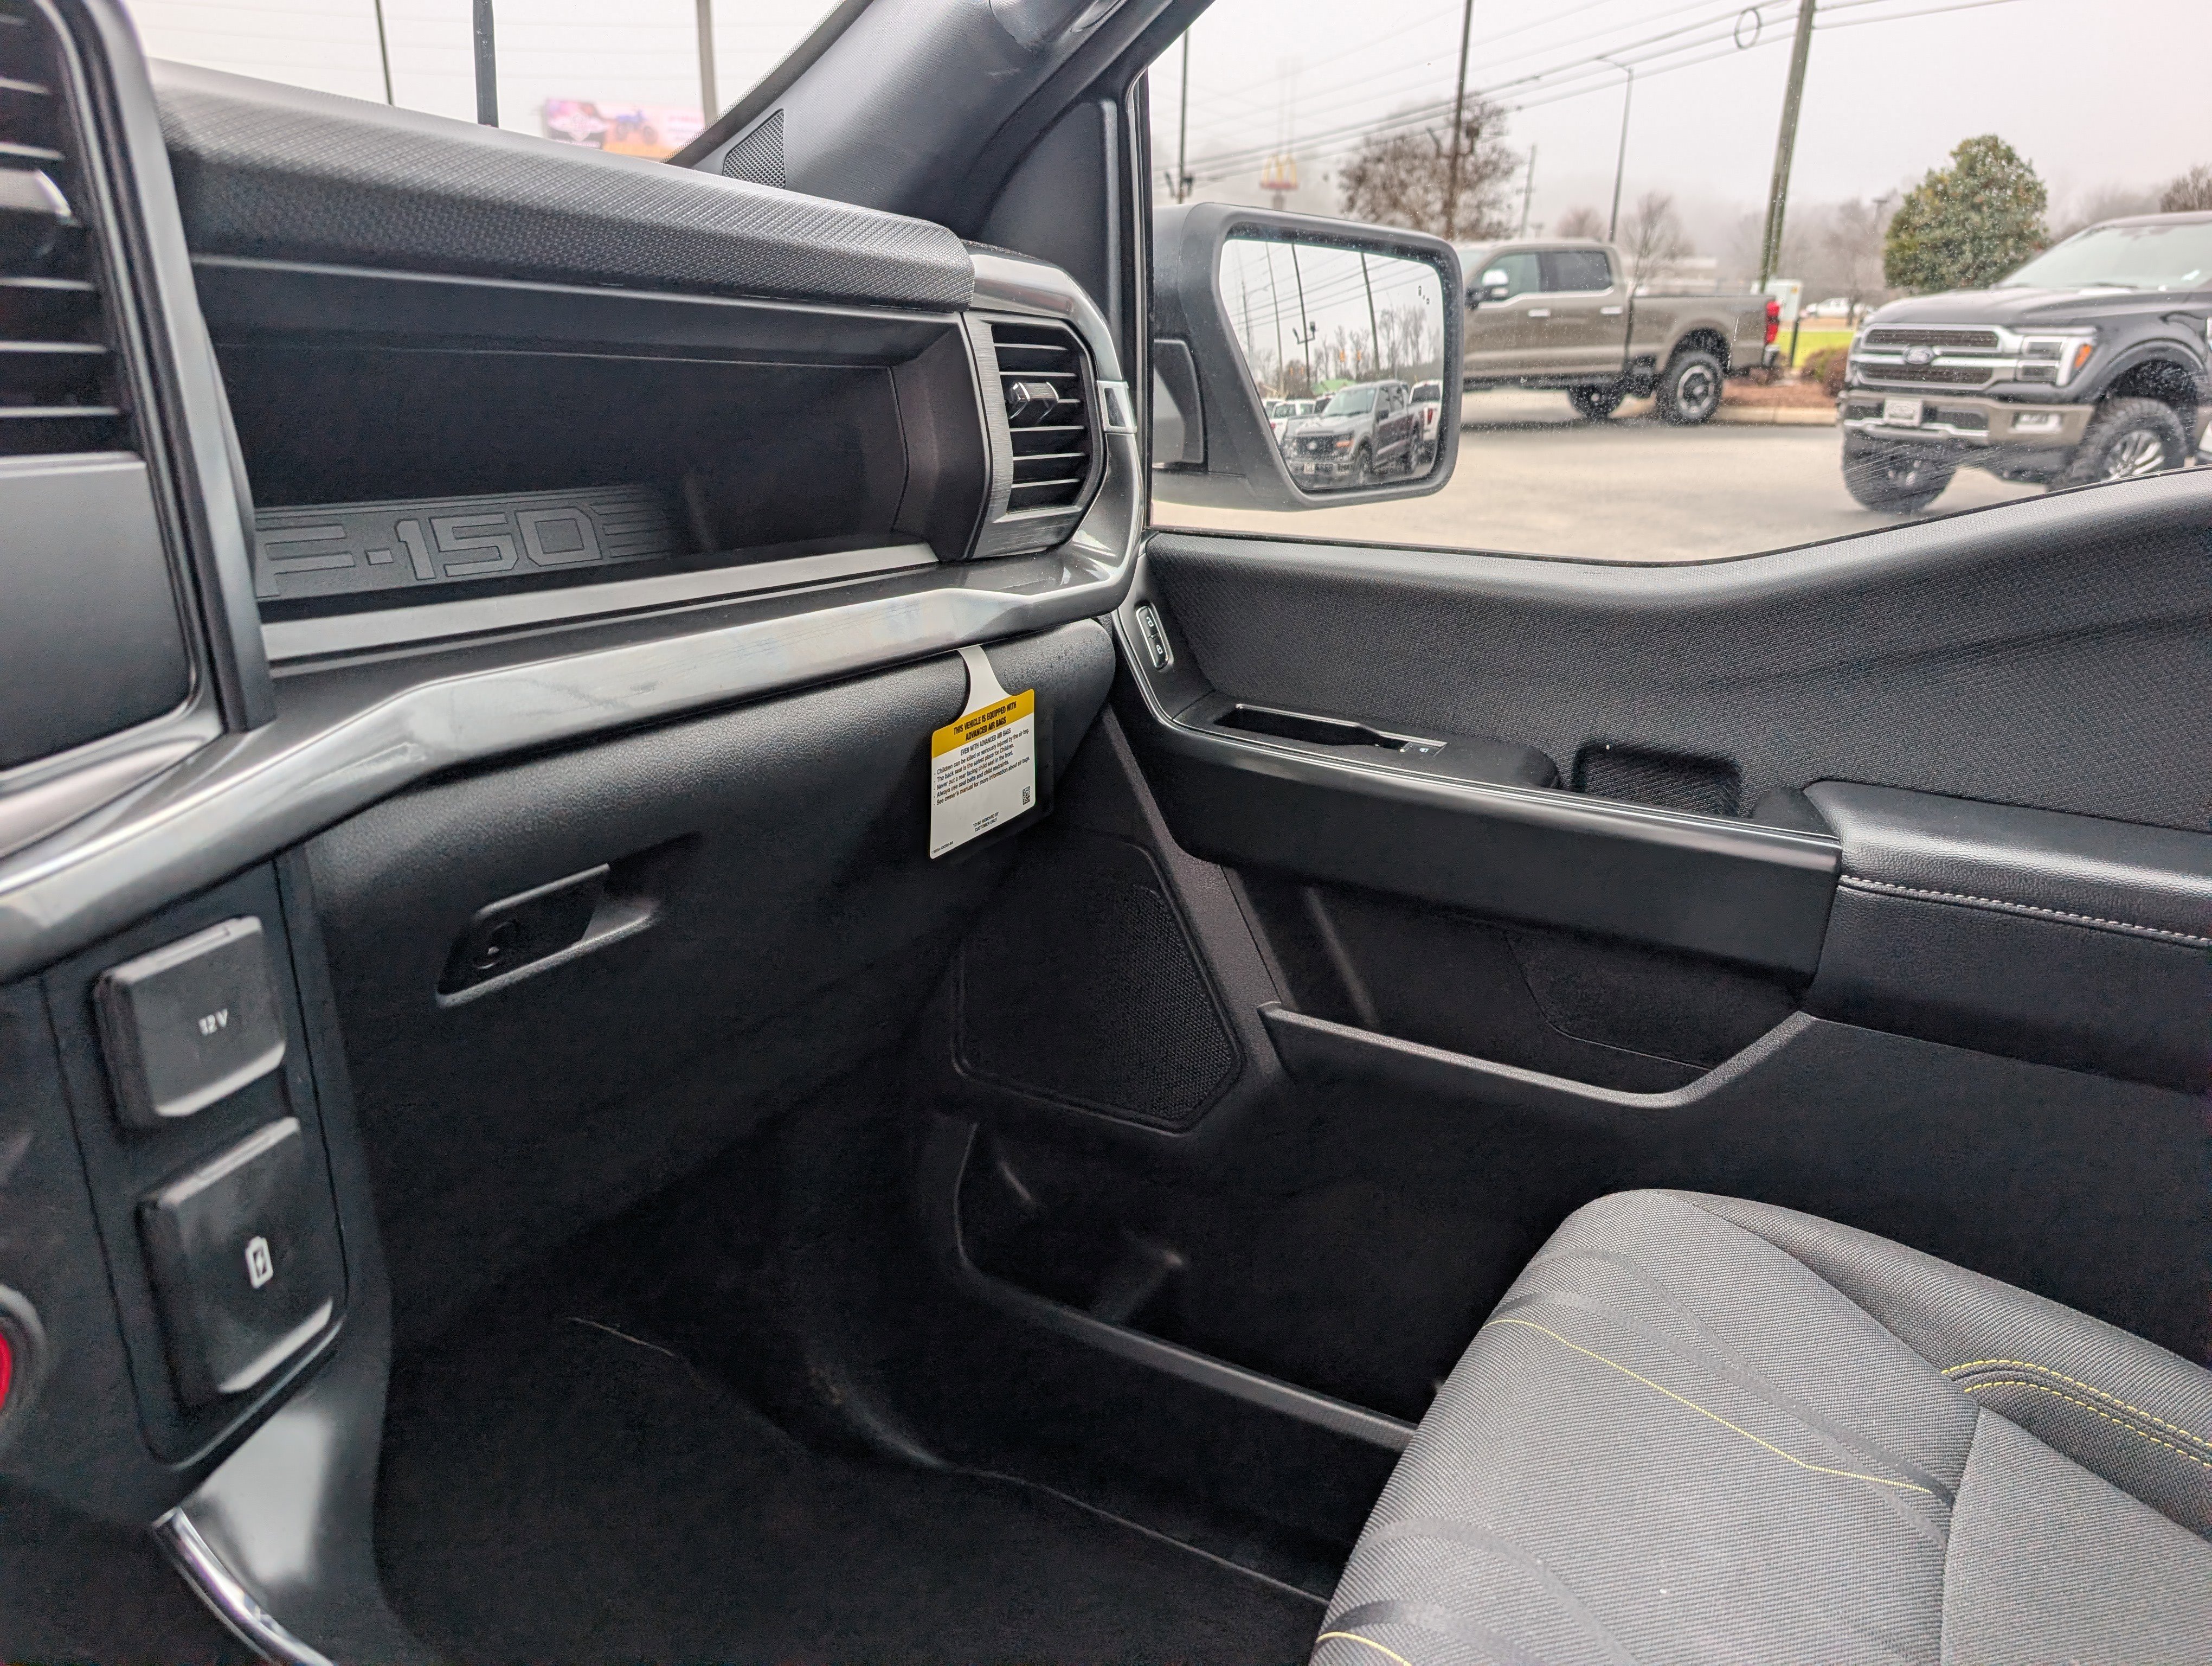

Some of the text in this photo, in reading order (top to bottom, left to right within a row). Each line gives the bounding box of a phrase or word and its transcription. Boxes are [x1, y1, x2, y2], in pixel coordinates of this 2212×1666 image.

[256, 506, 602, 598] F-150
[954, 701, 1017, 735] THIS VEHICLE IS EQUIPPED WITH
[966, 725, 987, 741] ADVANCED
[996, 716, 1006, 727] BAGS
[937, 765, 953, 774] Children
[966, 753, 976, 761] killed
[981, 744, 996, 755] seriously
[997, 738, 1008, 747] injured
[961, 747, 969, 756] EVEN
[970, 742, 979, 751] WITH
[980, 735, 996, 747] ADVANCED
[1002, 728, 1011, 736] BAGS
[937, 781, 948, 790] Never
[967, 768, 978, 776] facing
[978, 762, 987, 771] child
[1005, 750, 1013, 758] front.
[937, 788, 950, 798] Always
[983, 767, 992, 776] child
[993, 760, 1009, 771] restraints.
[945, 771, 954, 779] back
[974, 757, 984, 766] safest
[985, 753, 994, 761] place
[1000, 744, 1014, 753] Children.
[944, 791, 959, 801] owner's
[960, 783, 973, 794] manual
[989, 768, 1008, 780] information
[1008, 762, 1017, 771] about
[975, 822, 989, 832] CUSTOMER
[982, 814, 994, 823] REMOVED
